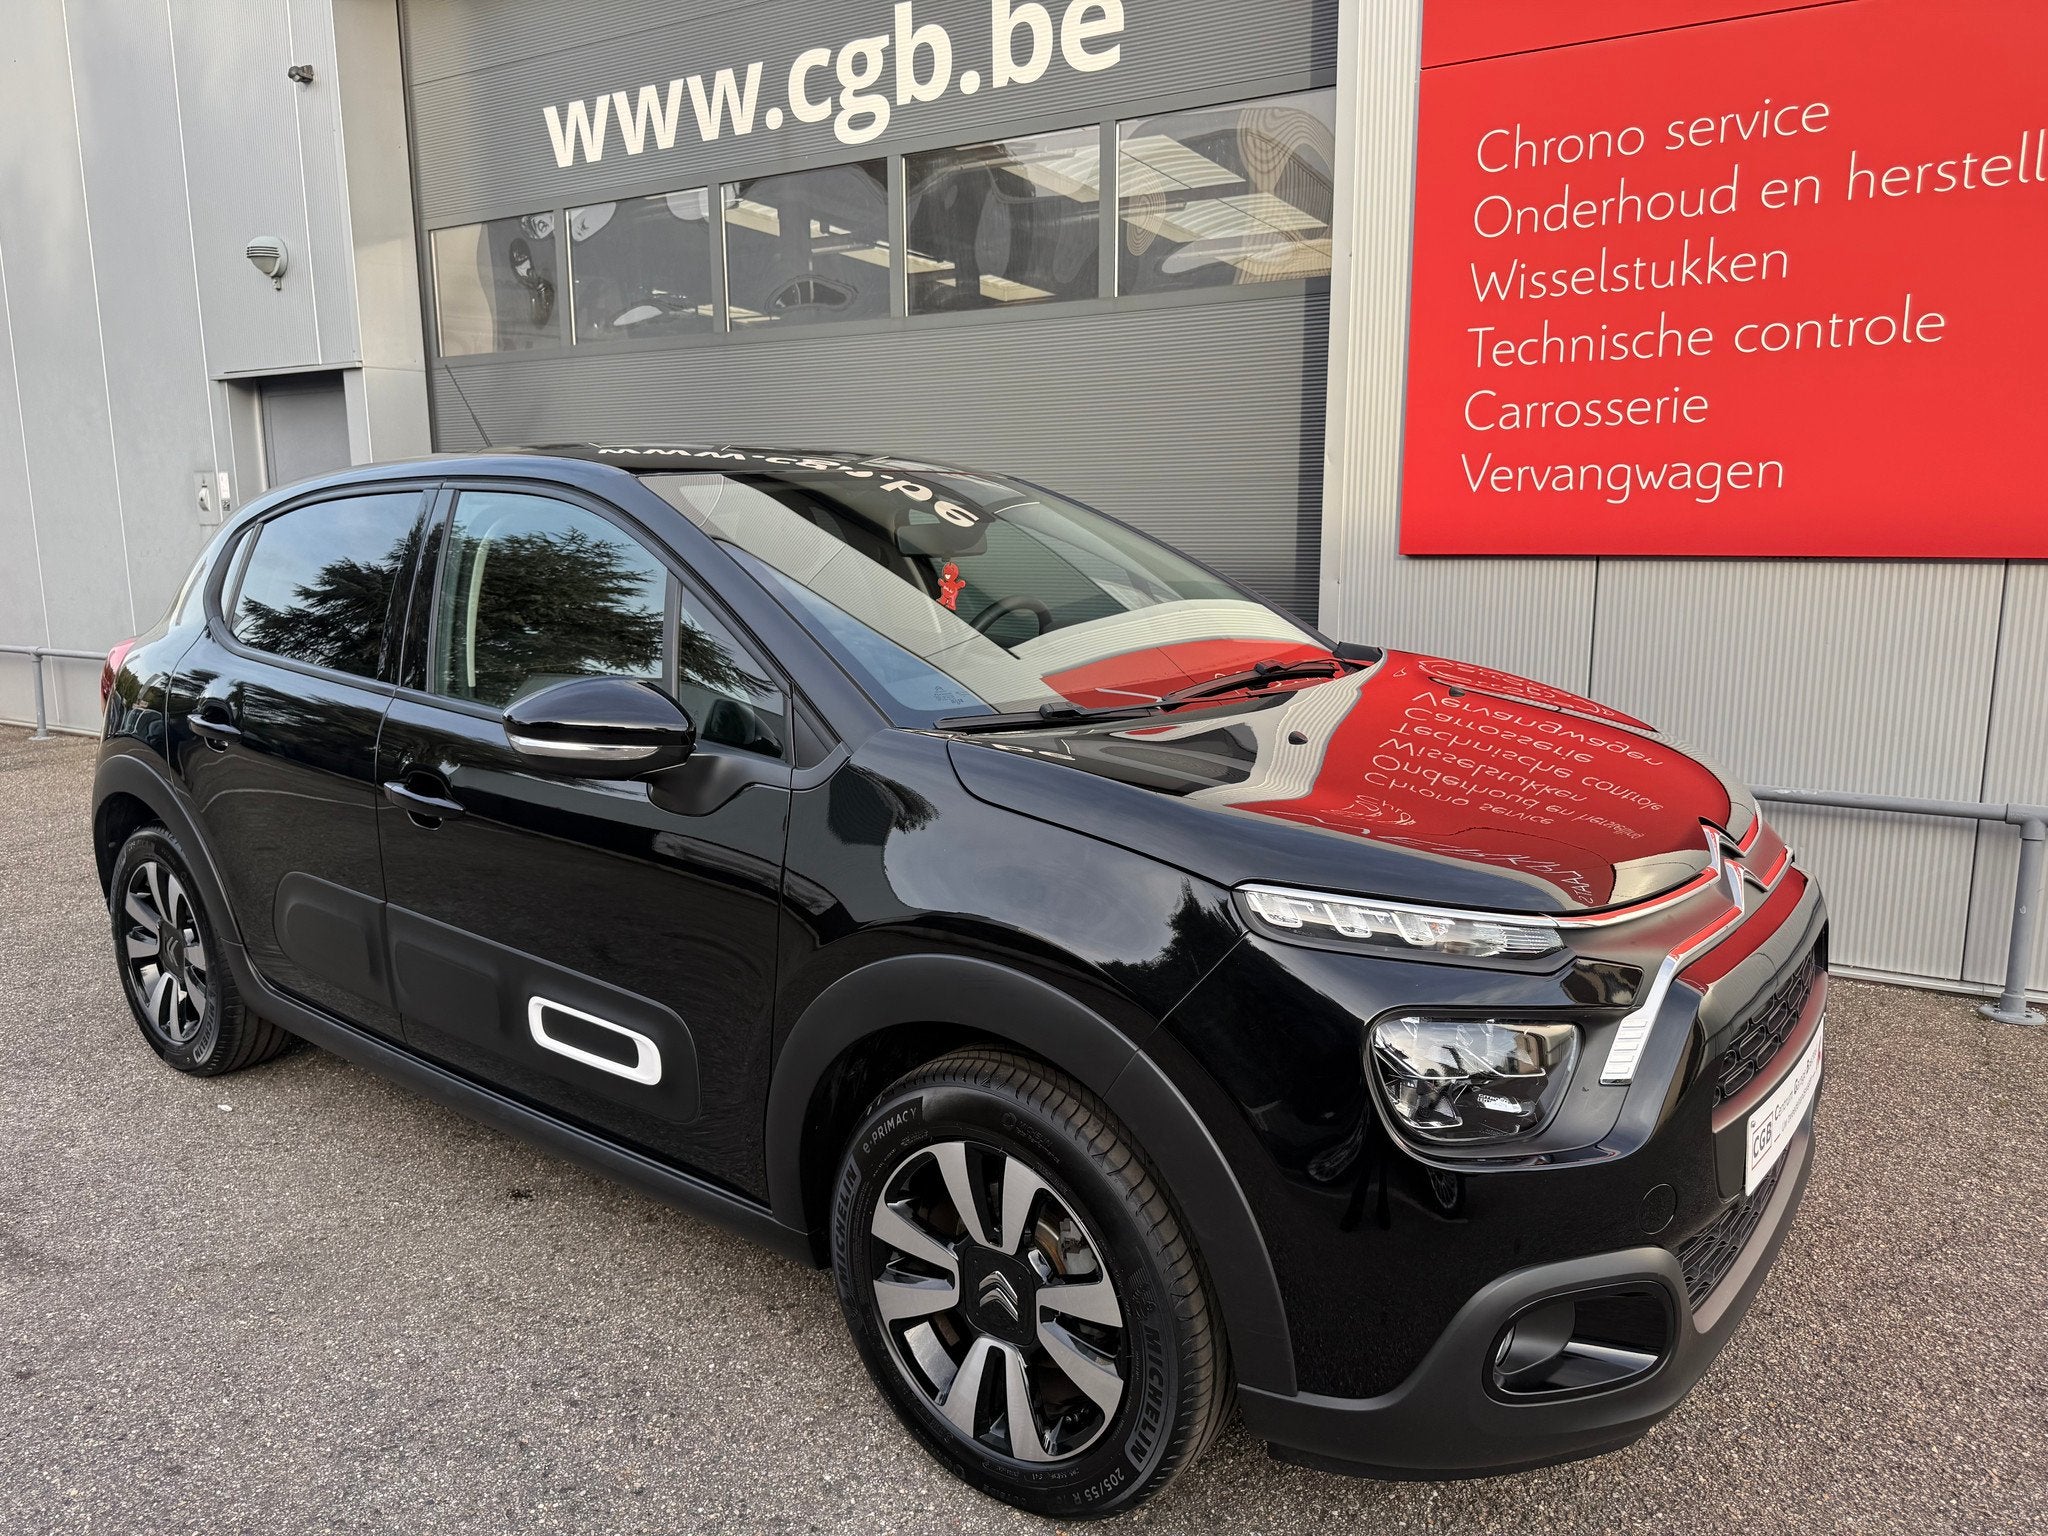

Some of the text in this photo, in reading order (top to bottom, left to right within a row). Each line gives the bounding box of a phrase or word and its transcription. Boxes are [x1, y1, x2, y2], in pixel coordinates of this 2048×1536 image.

[542, 0, 1125, 168] www.cgb.be
[1477, 98, 1830, 173] Chrono service
[1474, 128, 2047, 238] Onderhoud en herstell
[1470, 236, 1788, 303] Wisselstukken
[1467, 293, 1946, 368] Technische controle
[1464, 386, 1710, 431] Carrosserie
[1461, 452, 1784, 504] Vervangwagen
[1753, 1121, 1773, 1159] CGB
[835, 1164, 859, 1287] MICHELIN
[1130, 1325, 1165, 1465] MICHELIN
[1084, 1466, 1126, 1502] 205/55
